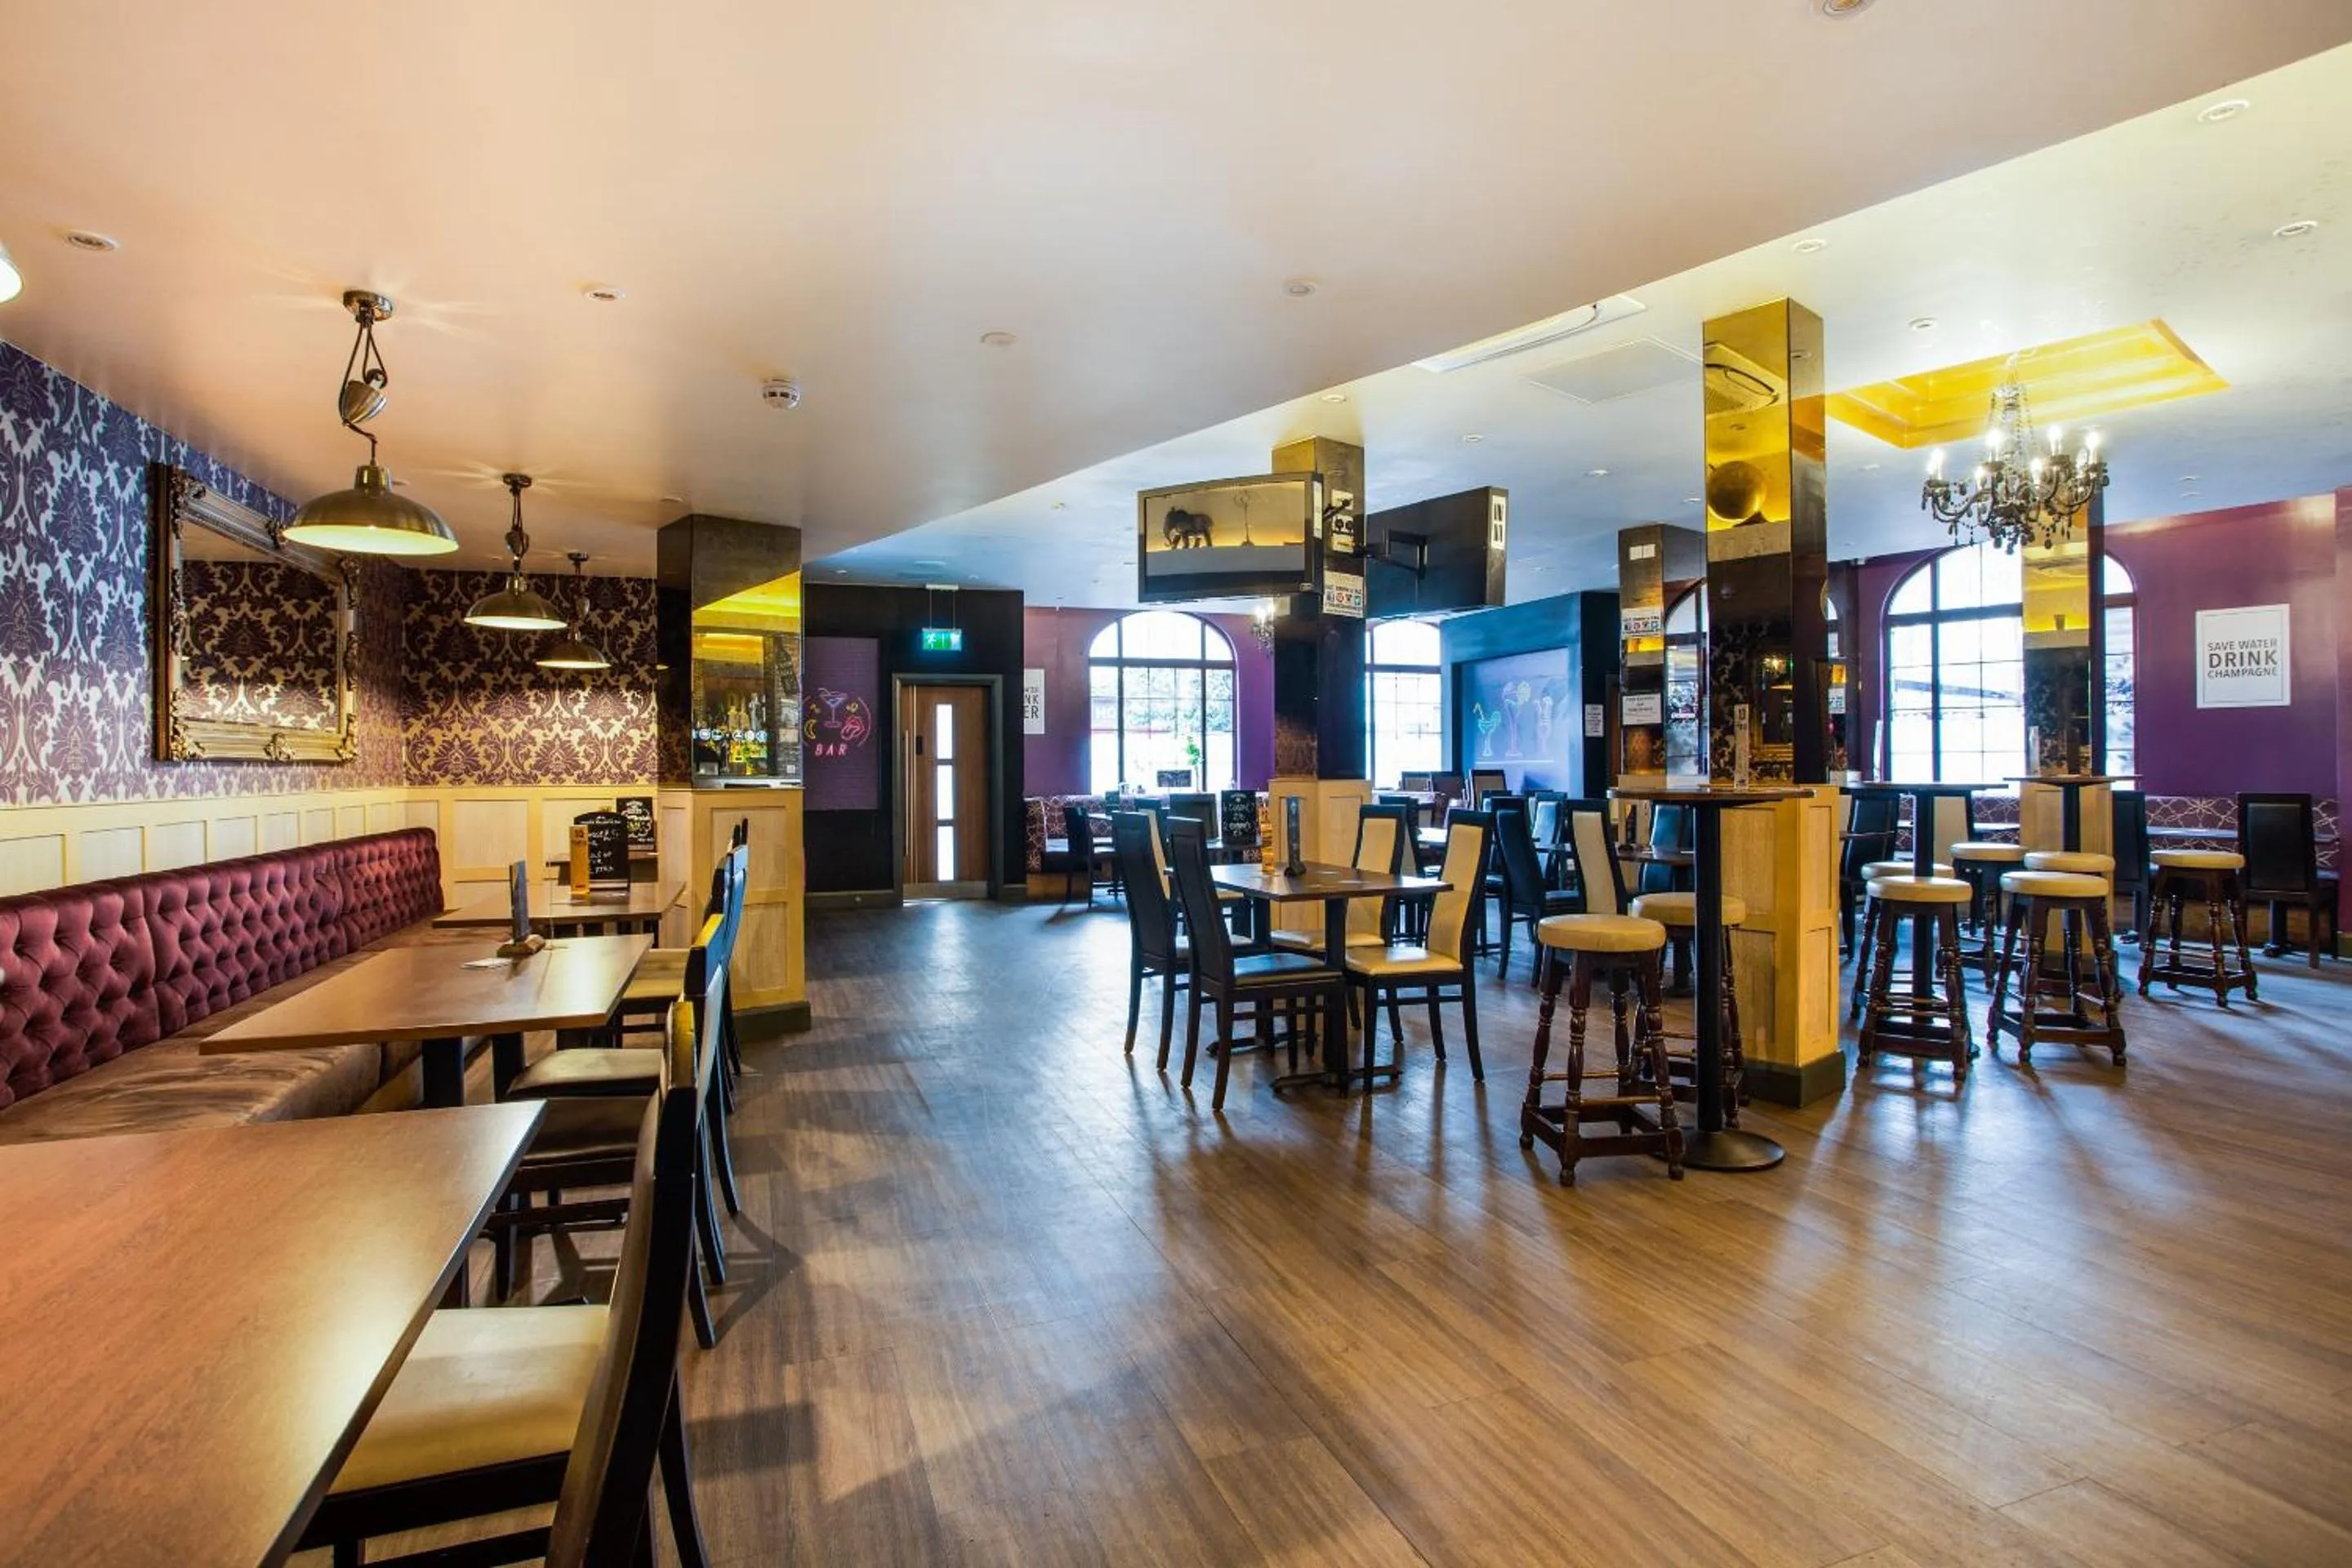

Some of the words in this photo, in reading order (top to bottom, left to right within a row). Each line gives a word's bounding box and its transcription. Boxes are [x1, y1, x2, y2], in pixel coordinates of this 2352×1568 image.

[2207, 641, 2235, 652] SAVE
[2238, 639, 2278, 650] WATER
[2209, 650, 2278, 669] DRINK
[2207, 667, 2279, 679] CHAMPAGNE
[815, 742, 847, 756] BAR
